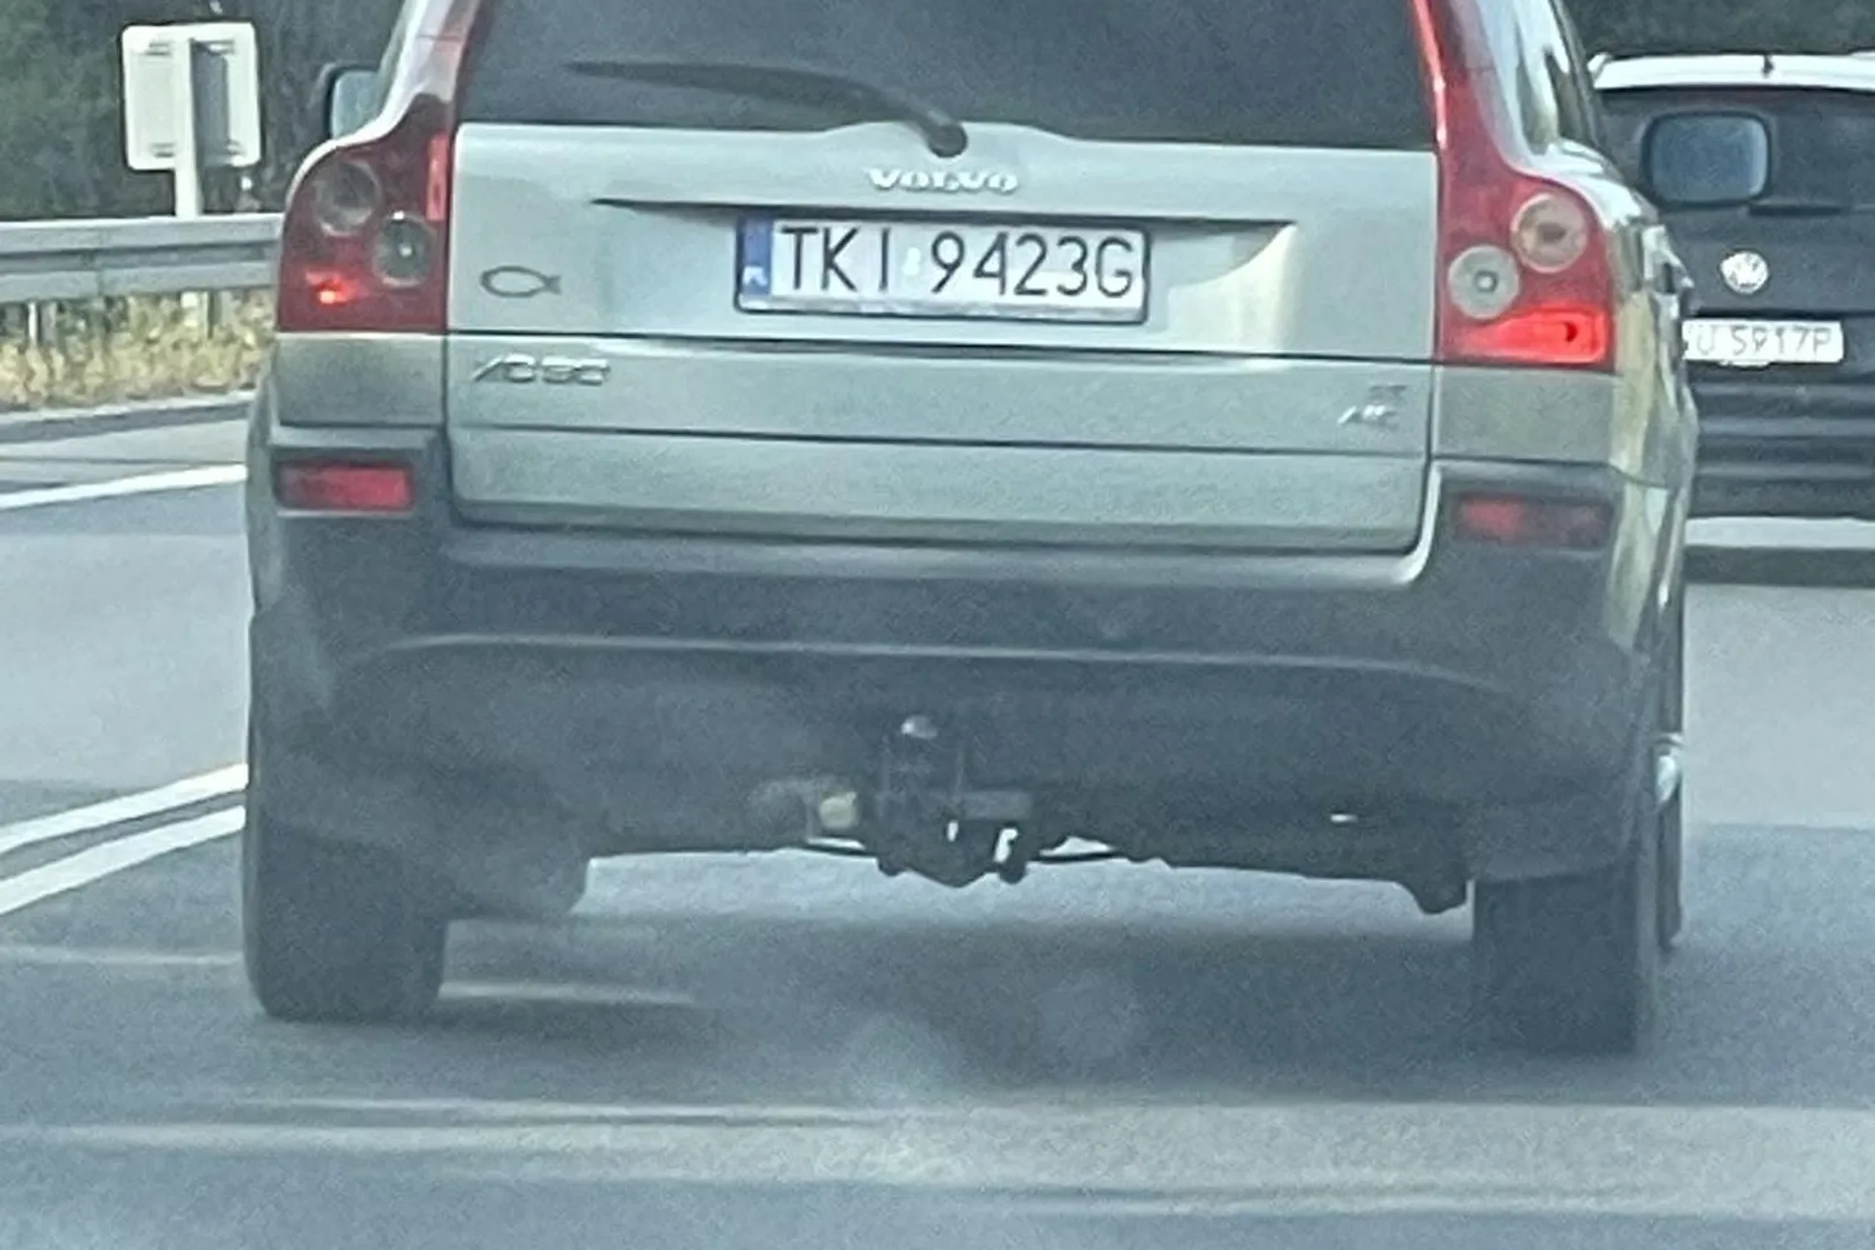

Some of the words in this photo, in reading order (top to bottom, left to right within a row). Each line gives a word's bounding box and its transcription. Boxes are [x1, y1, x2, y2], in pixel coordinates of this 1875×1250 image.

[865, 167, 1020, 194] VOLVO
[780, 226, 890, 292] TKI
[930, 229, 1134, 298] 9423G
